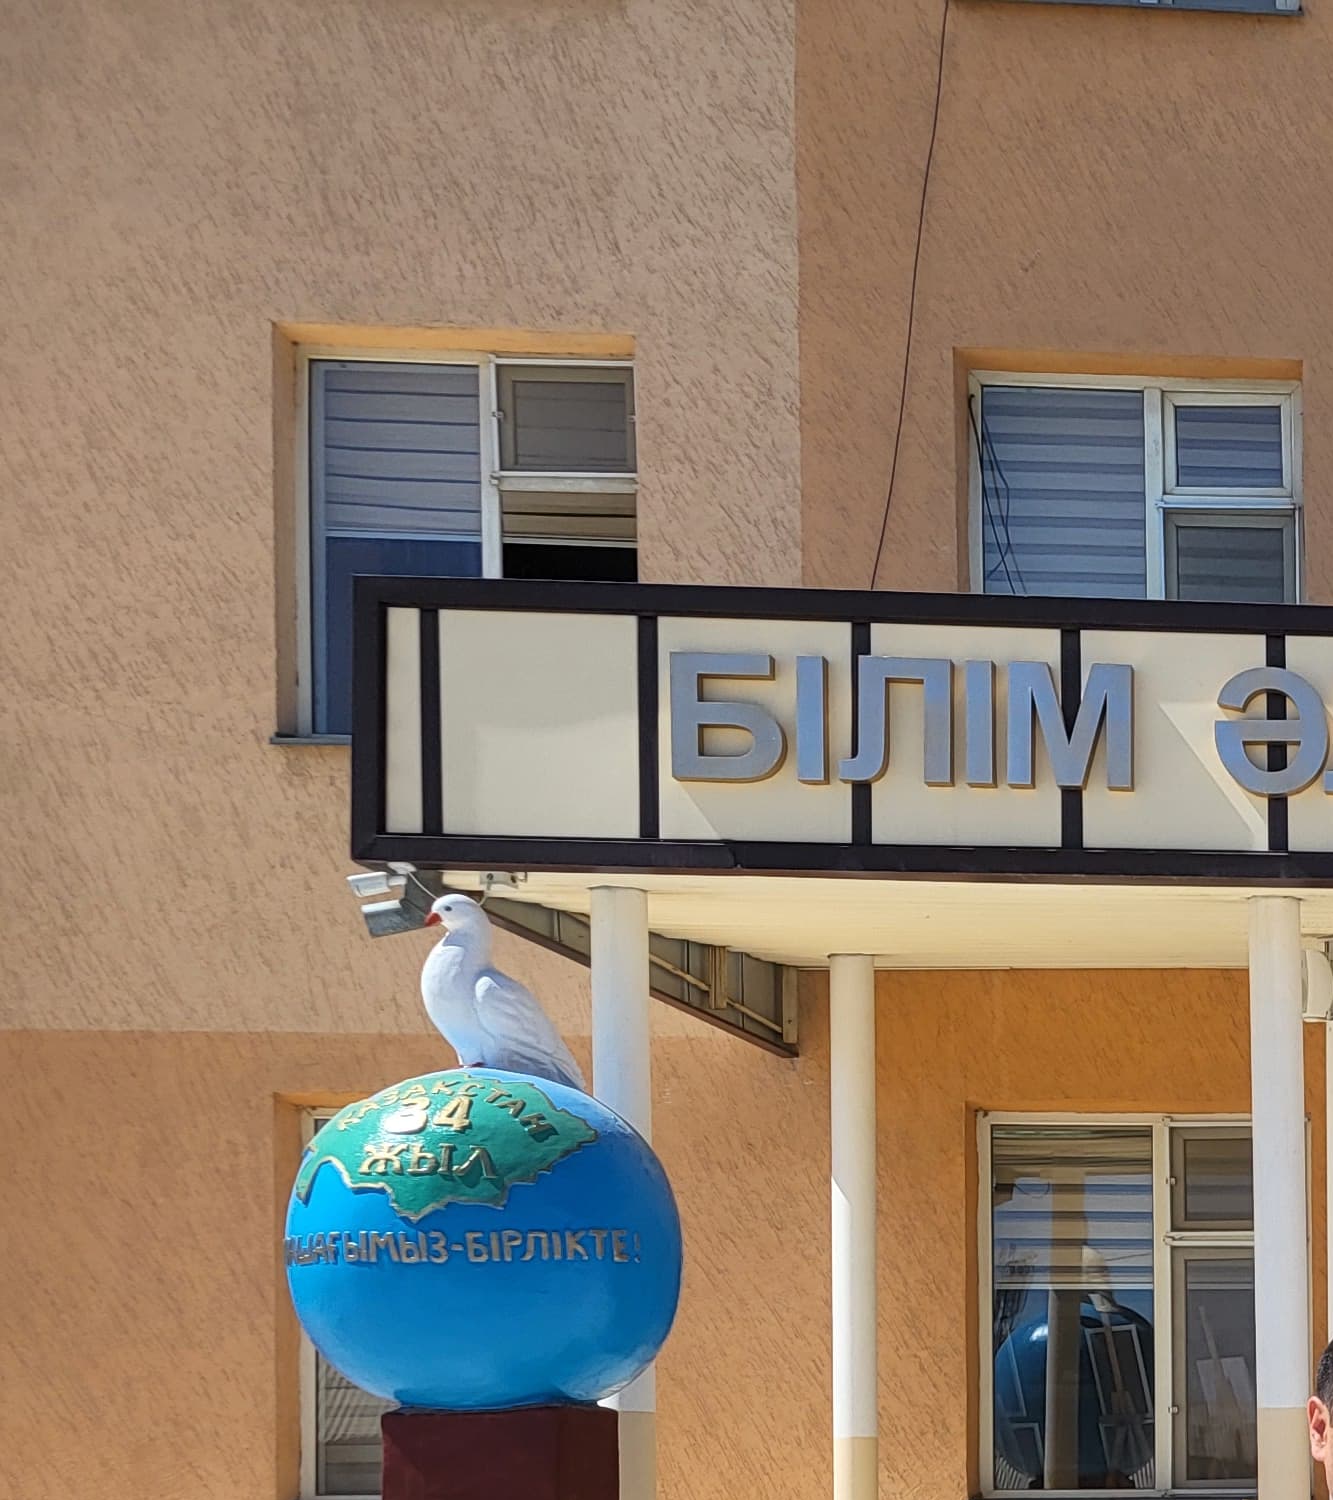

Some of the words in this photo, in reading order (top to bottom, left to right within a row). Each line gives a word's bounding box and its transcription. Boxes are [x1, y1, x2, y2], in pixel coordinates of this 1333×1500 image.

[671, 651, 1135, 792] БІЛІМ
[383, 1095, 473, 1136] 34
[359, 1142, 499, 1180] ЖЫЛ
